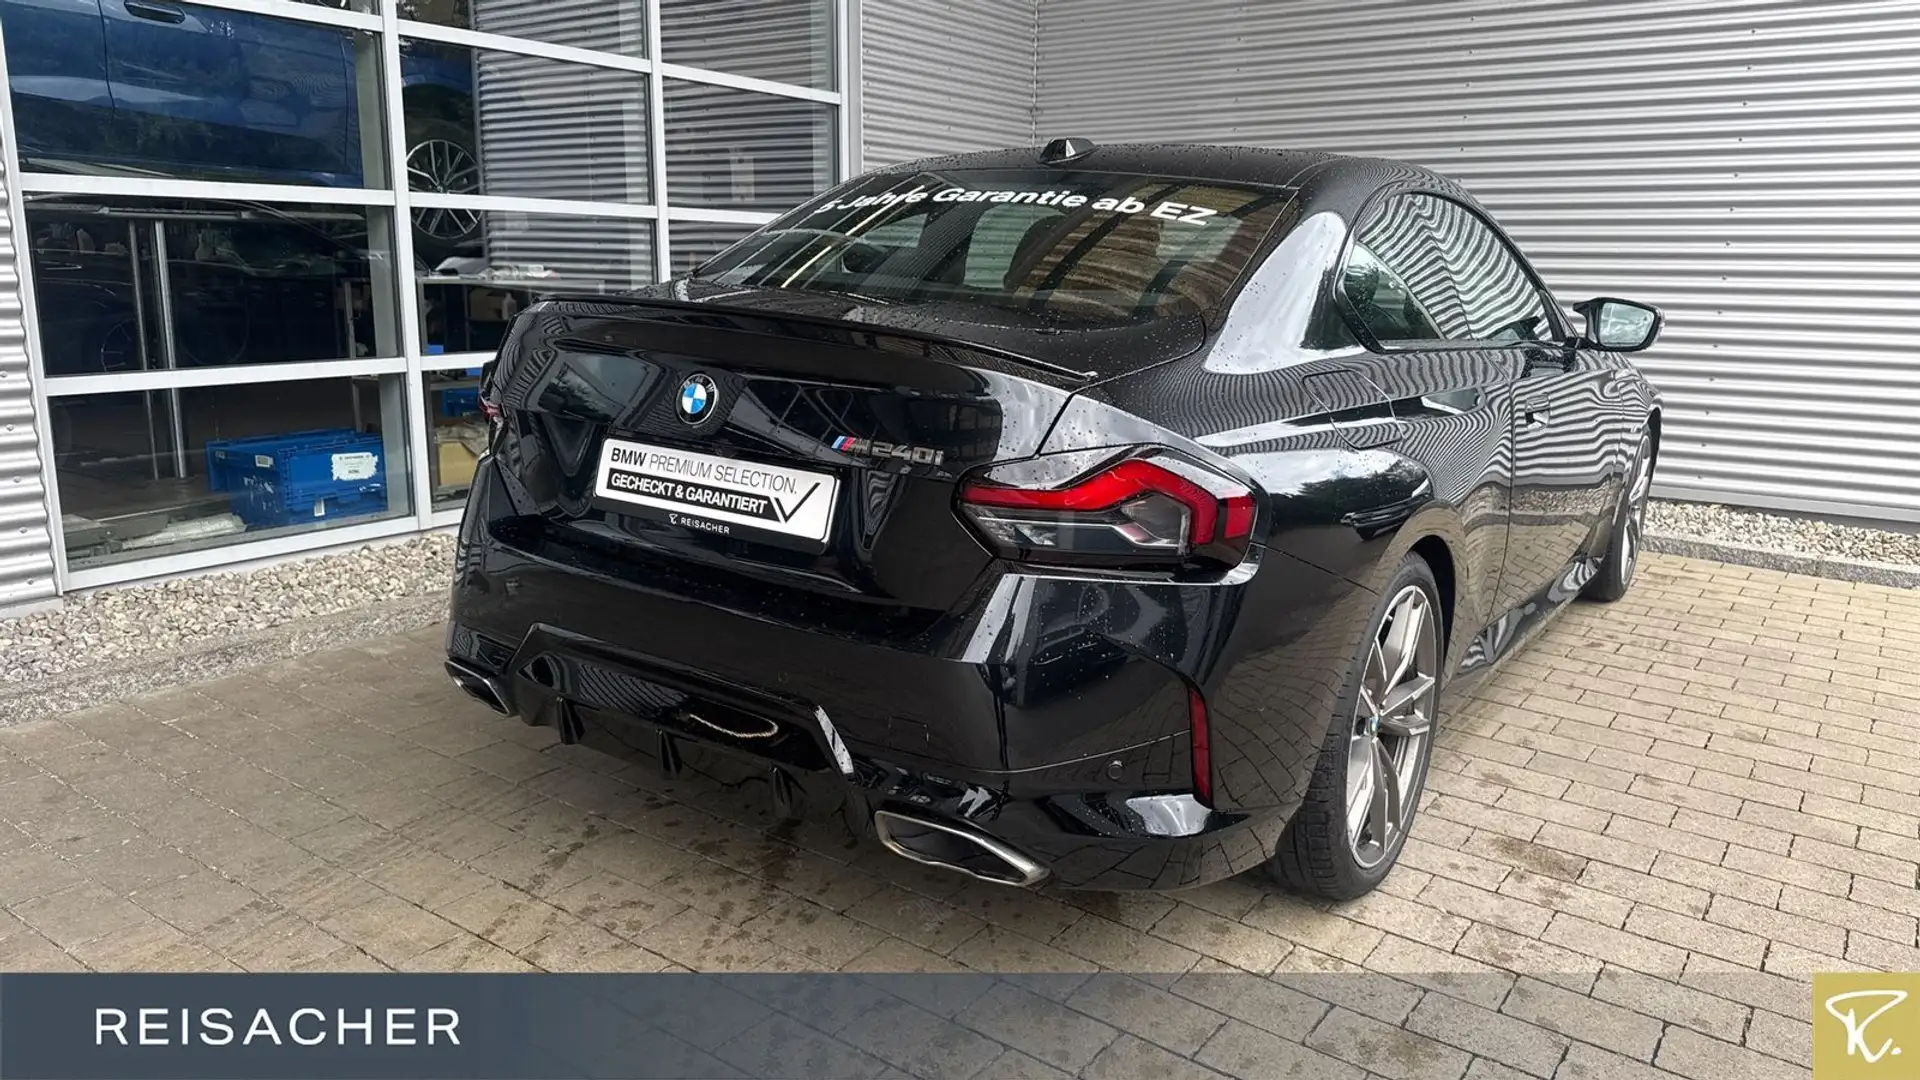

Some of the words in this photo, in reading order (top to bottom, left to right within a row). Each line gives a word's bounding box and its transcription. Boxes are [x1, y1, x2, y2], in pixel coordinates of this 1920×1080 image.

[932, 187, 1088, 207] Garantie
[1091, 196, 1145, 214] ab
[1150, 201, 1218, 226] EZ
[610, 447, 647, 467] BMW
[650, 453, 713, 480] PREMIUM
[611, 472, 675, 496] GECHECKT
[675, 485, 684, 499] &
[685, 486, 768, 514] GARANTIERT
[680, 517, 730, 535] REISACHER
